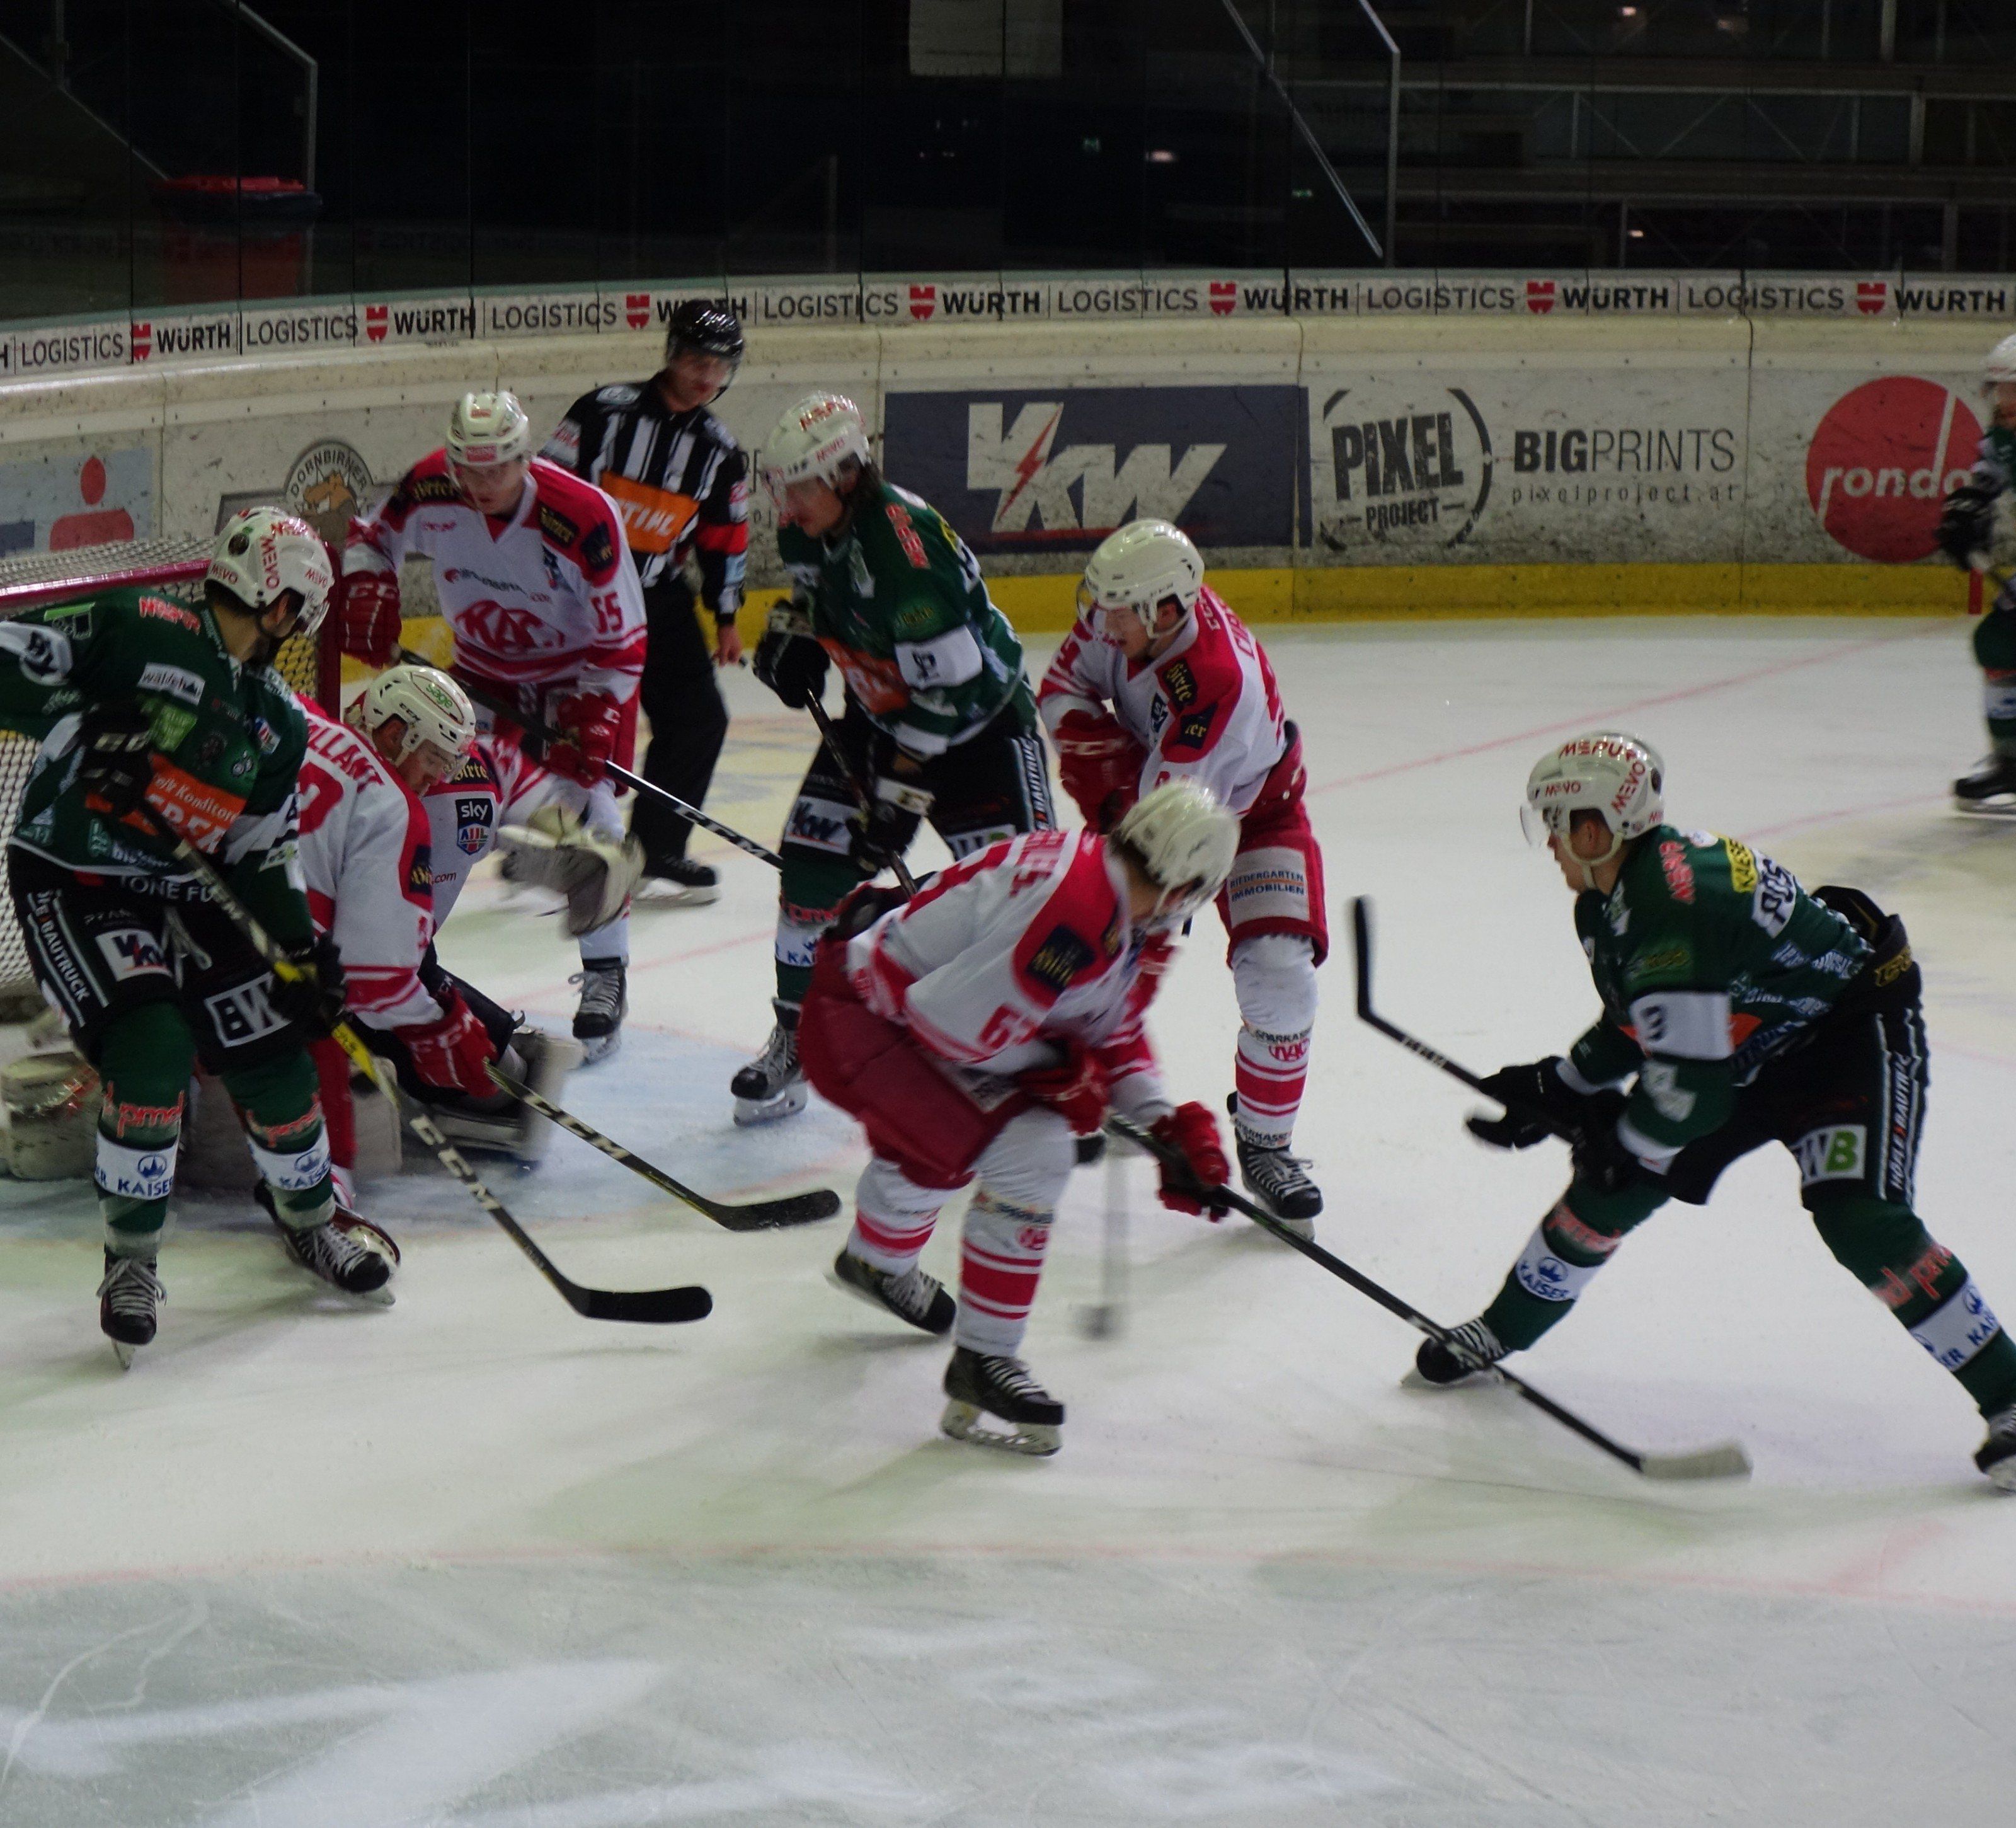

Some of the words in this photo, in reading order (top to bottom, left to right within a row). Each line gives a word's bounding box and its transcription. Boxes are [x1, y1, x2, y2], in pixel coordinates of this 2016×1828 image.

[764, 292, 898, 319] LOGISTICS
[942, 290, 1040, 314] WÜRTH
[1058, 288, 1198, 313] LOGISTICS
[1244, 288, 1348, 311] WÜRTH
[1368, 287, 1515, 310] LOGISTICS
[1563, 287, 1669, 309] WÜRTH
[1688, 287, 1843, 310] LOGISTICS
[1894, 289, 2006, 312] WÜRTH
[158, 324, 230, 354] WÜRTH
[246, 315, 358, 346] LOGISTICS
[394, 307, 472, 335] WÜRTH
[492, 302, 616, 330] LOGISTICS
[22, 333, 123, 367] LOGISTICS
[289, 449, 367, 497] DORNBIRNER
[1332, 412, 1464, 502] PIXEL
[1366, 497, 1440, 531] PROJECT
[260, 534, 280, 590] MEVO
[1610, 759, 1646, 815] MEVO
[461, 801, 489, 820] sky
[1232, 883, 1304, 902] IMMOBILIEN
[41, 921, 90, 1003] BAUTRUCK
[524, 1093, 631, 1160] CCM
[410, 1112, 502, 1210] CCM
